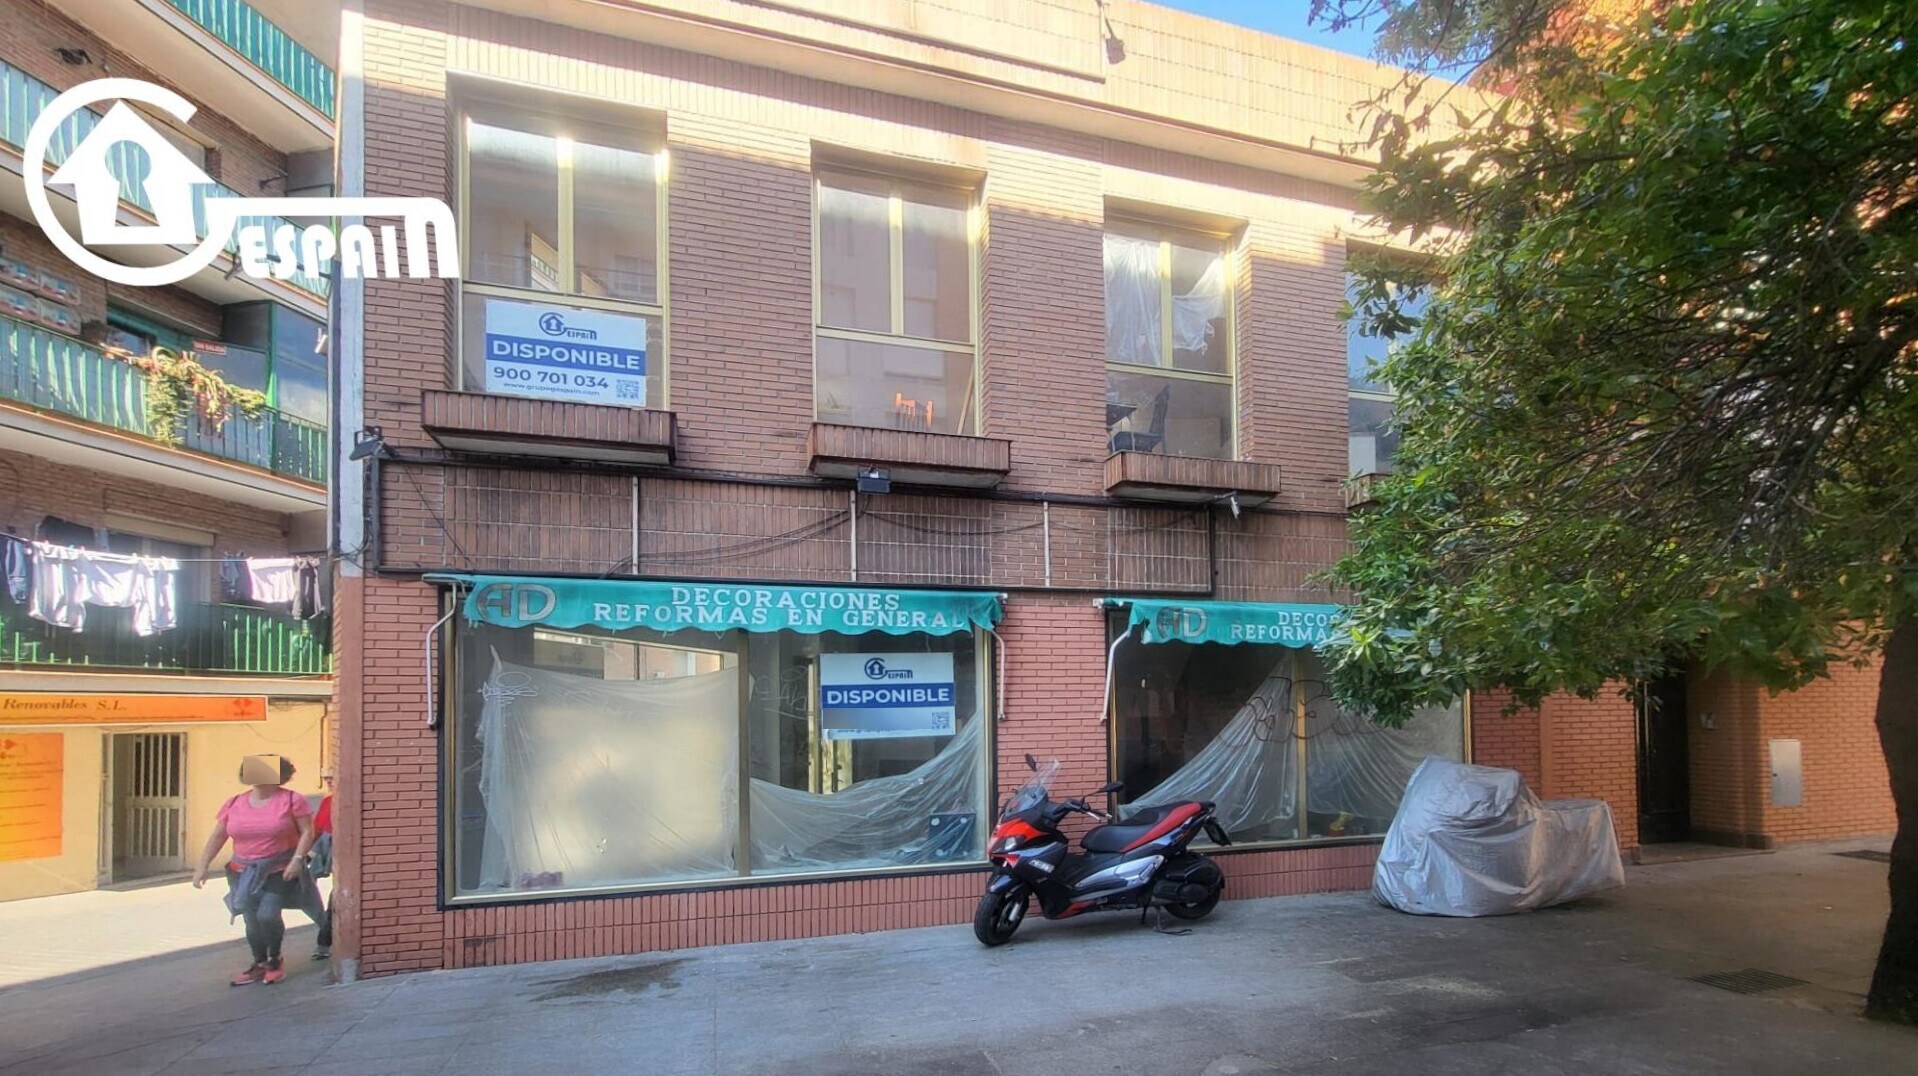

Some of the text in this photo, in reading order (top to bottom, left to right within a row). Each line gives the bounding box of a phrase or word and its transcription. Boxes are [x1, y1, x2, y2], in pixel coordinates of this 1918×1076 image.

[492, 340, 640, 370] DISPONIBLE
[493, 366, 609, 389] 900 701 034
[476, 583, 556, 621] AD
[671, 587, 899, 611] DECORACIONES
[593, 603, 965, 628] REFORMAS EN GENERAL
[3, 698, 88, 710] Renovables
[827, 688, 950, 705] DISPONIBLE
